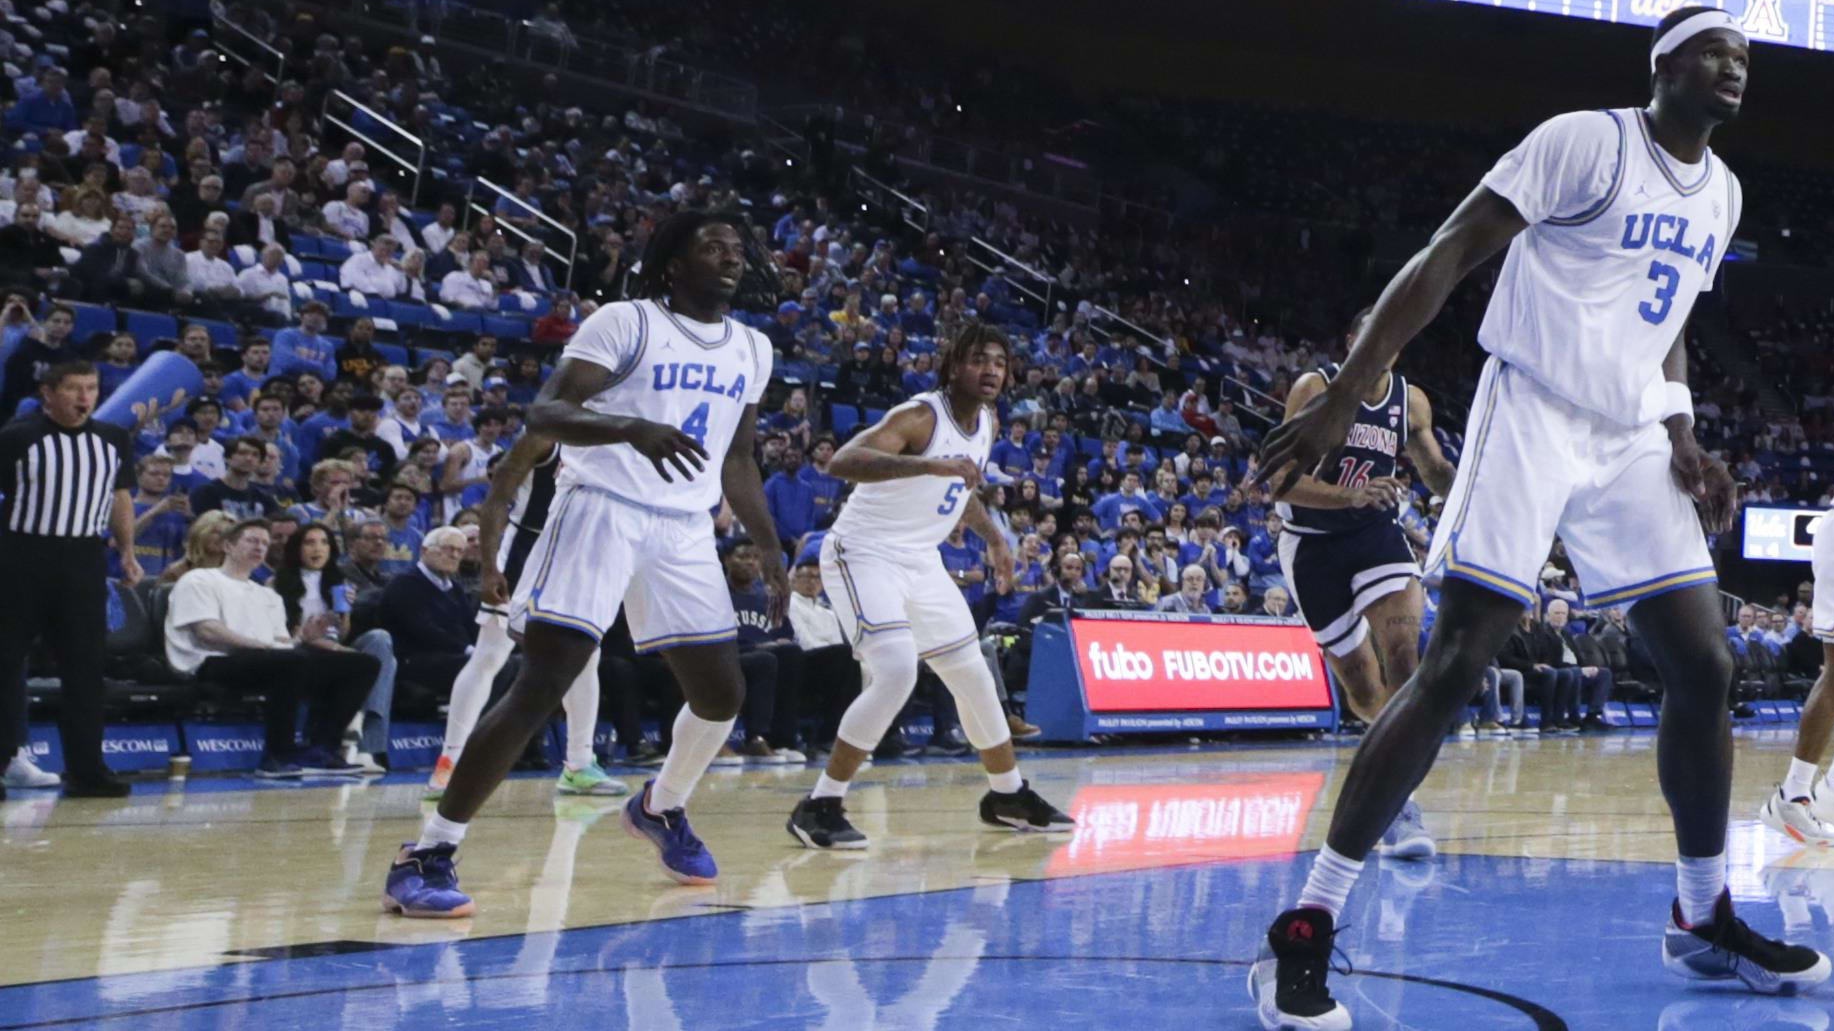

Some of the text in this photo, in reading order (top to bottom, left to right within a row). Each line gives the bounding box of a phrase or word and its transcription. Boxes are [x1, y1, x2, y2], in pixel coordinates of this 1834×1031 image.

[1620, 214, 1716, 274] UCLA
[1638, 259, 1682, 325] 3
[653, 363, 746, 399] UCLA
[680, 402, 710, 459] 4
[937, 482, 965, 516] 5
[1088, 642, 1313, 680] fubo FUBOTV.COM
[101, 739, 152, 753] ESCOM
[197, 738, 257, 753] WESCOM
